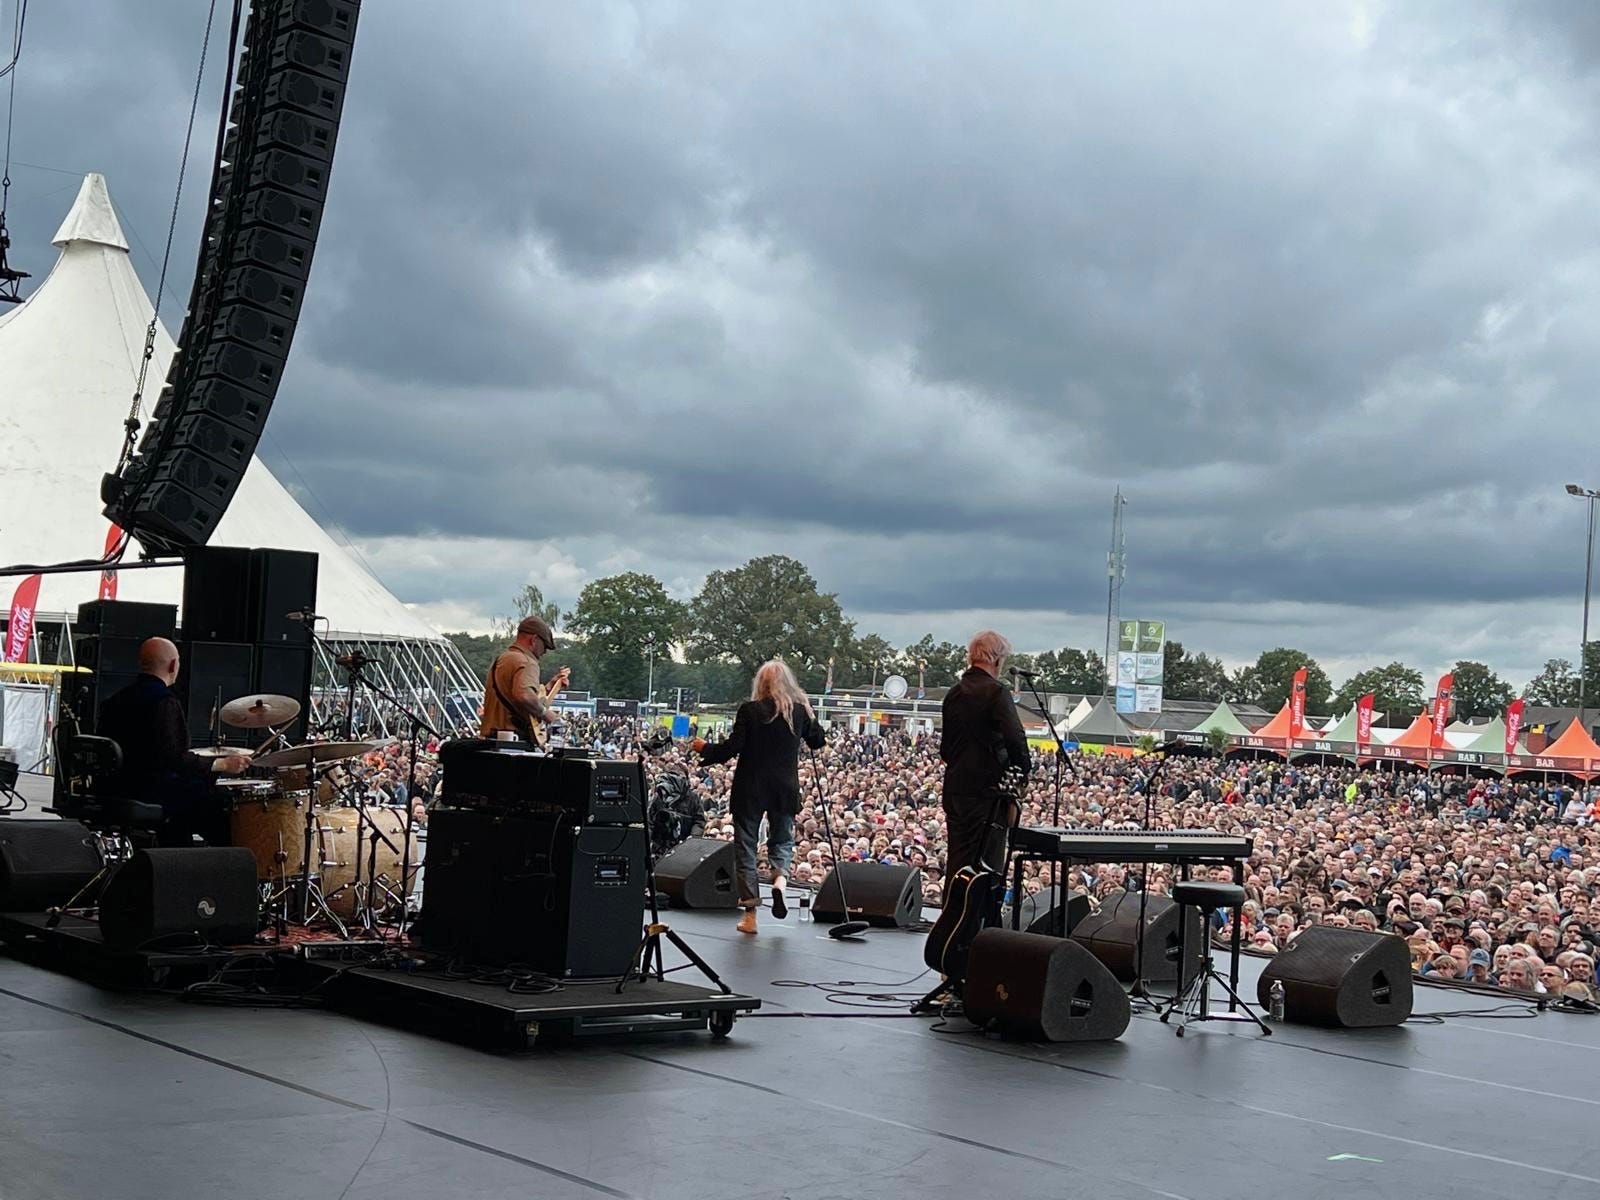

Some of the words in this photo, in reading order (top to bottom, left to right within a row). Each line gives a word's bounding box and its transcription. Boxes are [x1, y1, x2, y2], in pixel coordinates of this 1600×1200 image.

[1434, 702, 1446, 737] Jupiler
[1248, 737, 1264, 746] BAR
[1315, 742, 1331, 750] BAR
[1384, 747, 1401, 757] BAR
[1458, 753, 1476, 762] BAR
[1536, 758, 1555, 768] BAR
